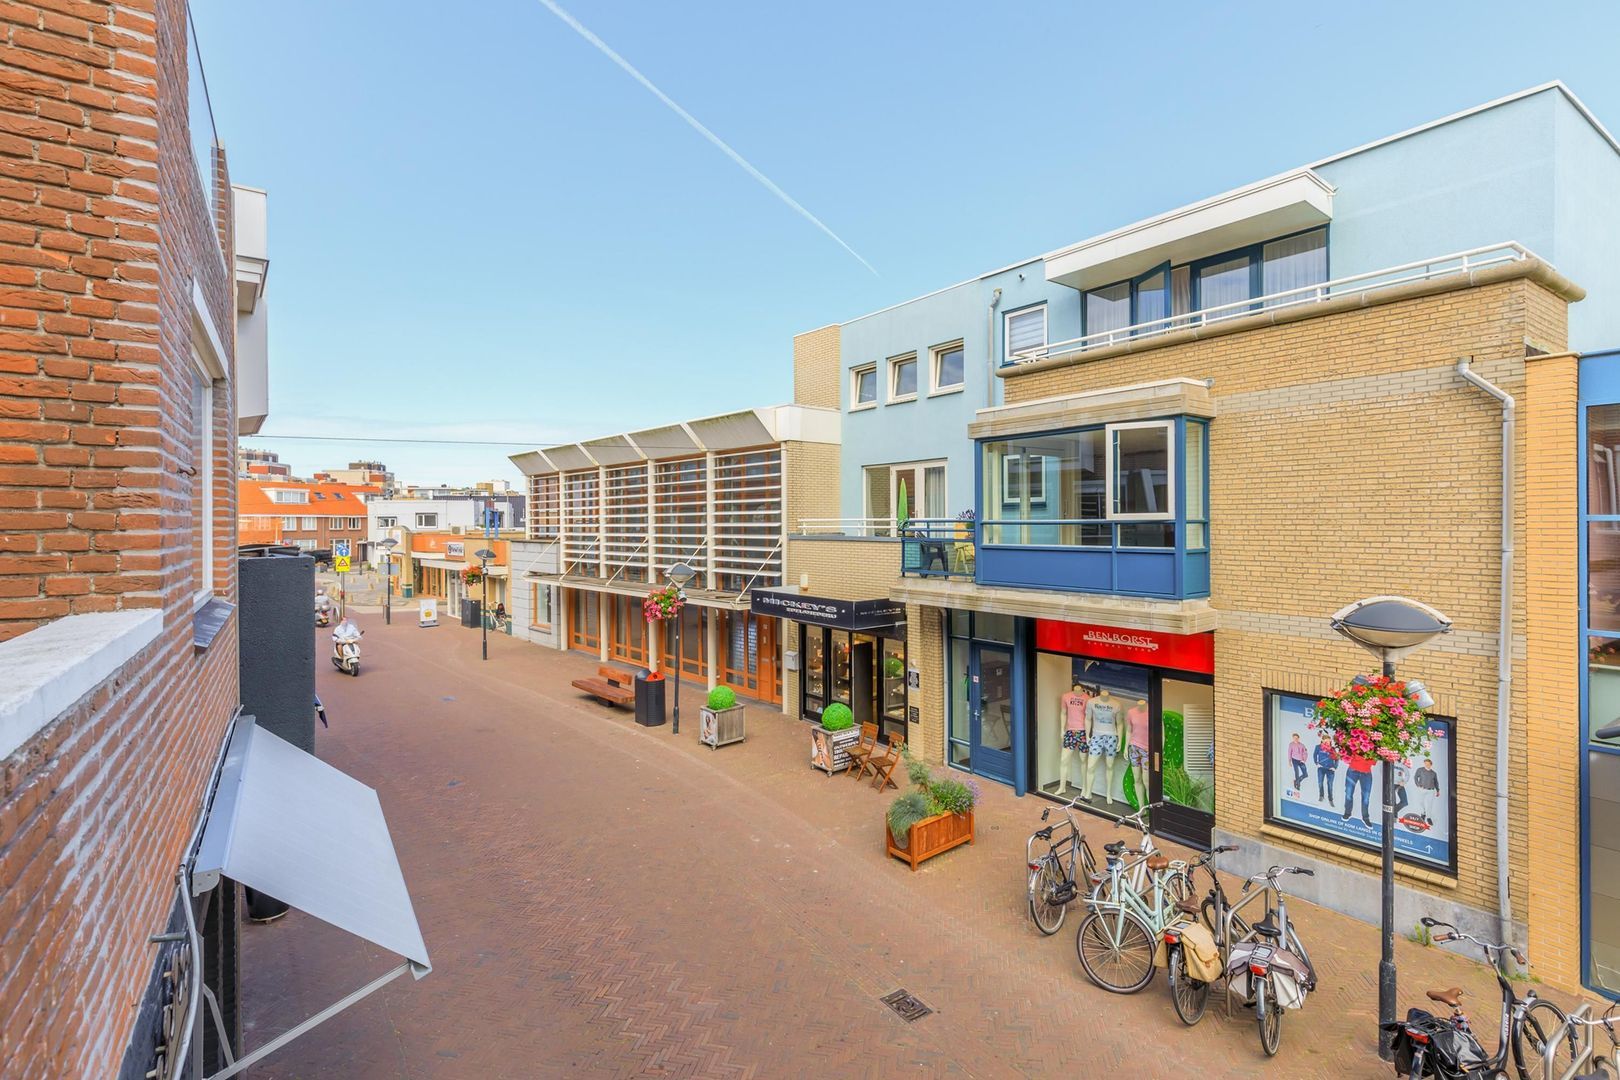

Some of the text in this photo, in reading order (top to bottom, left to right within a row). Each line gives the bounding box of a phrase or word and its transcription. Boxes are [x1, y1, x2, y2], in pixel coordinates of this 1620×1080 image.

[762, 597, 837, 613] MICKEY'S
[1088, 630, 1152, 645] BEN BORST
